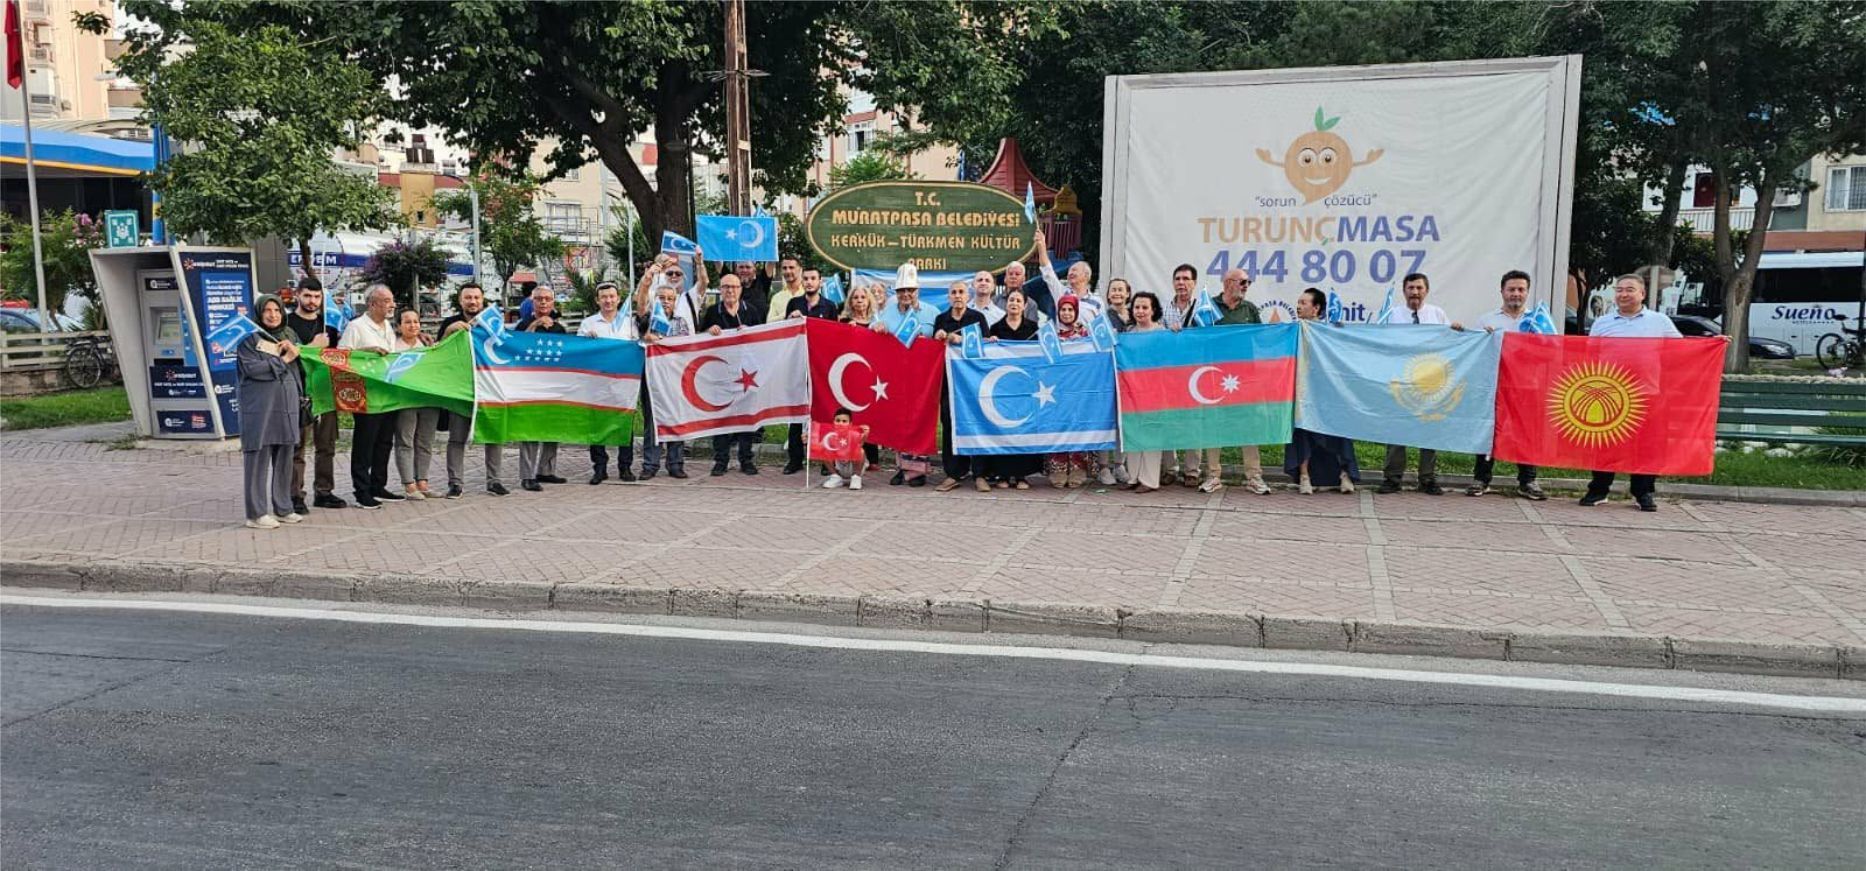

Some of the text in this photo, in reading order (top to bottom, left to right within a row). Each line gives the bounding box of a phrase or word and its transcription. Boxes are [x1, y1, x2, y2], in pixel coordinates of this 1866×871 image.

[915, 192, 941, 206] T.C.
[1198, 214, 1441, 246] TURUNÇMASA
[1206, 249, 1428, 284] 444 80 07
